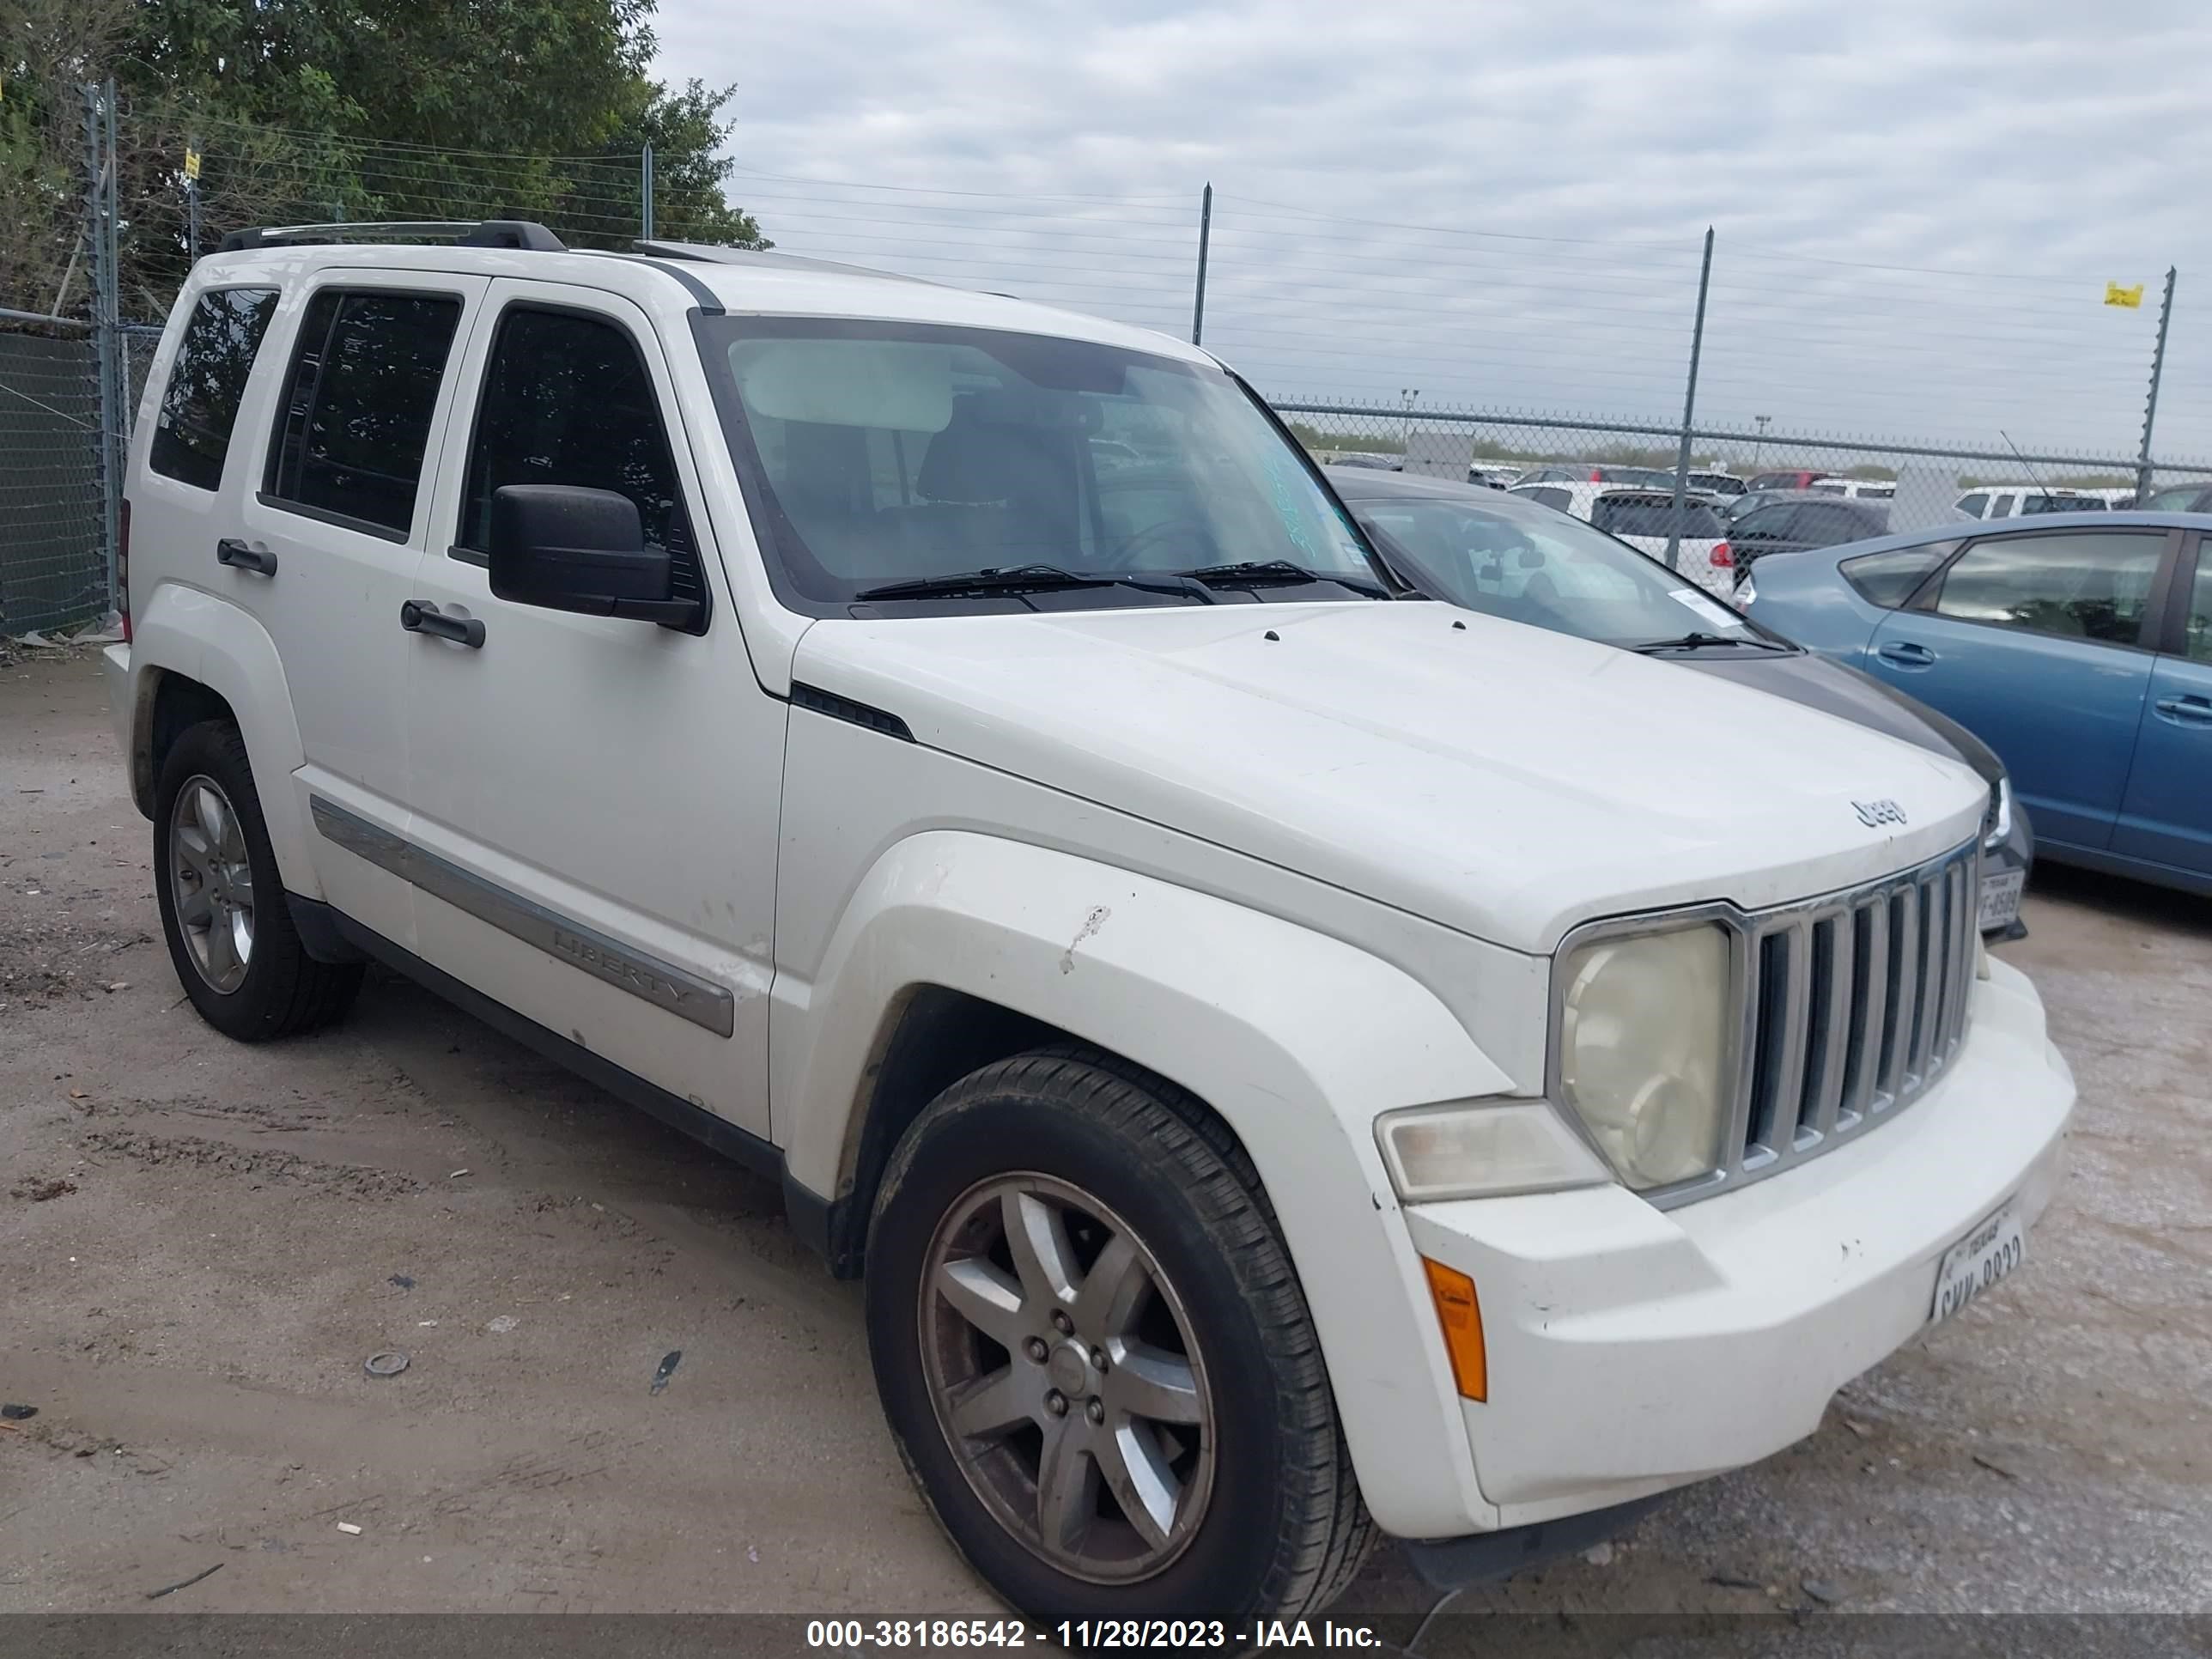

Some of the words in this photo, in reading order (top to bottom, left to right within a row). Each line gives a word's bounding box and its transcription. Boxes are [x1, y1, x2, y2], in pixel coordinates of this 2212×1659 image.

[1850, 799, 1908, 828] Jeep
[554, 930, 690, 1003] LIBERTY
[1968, 1218, 2000, 1260] TEXAS
